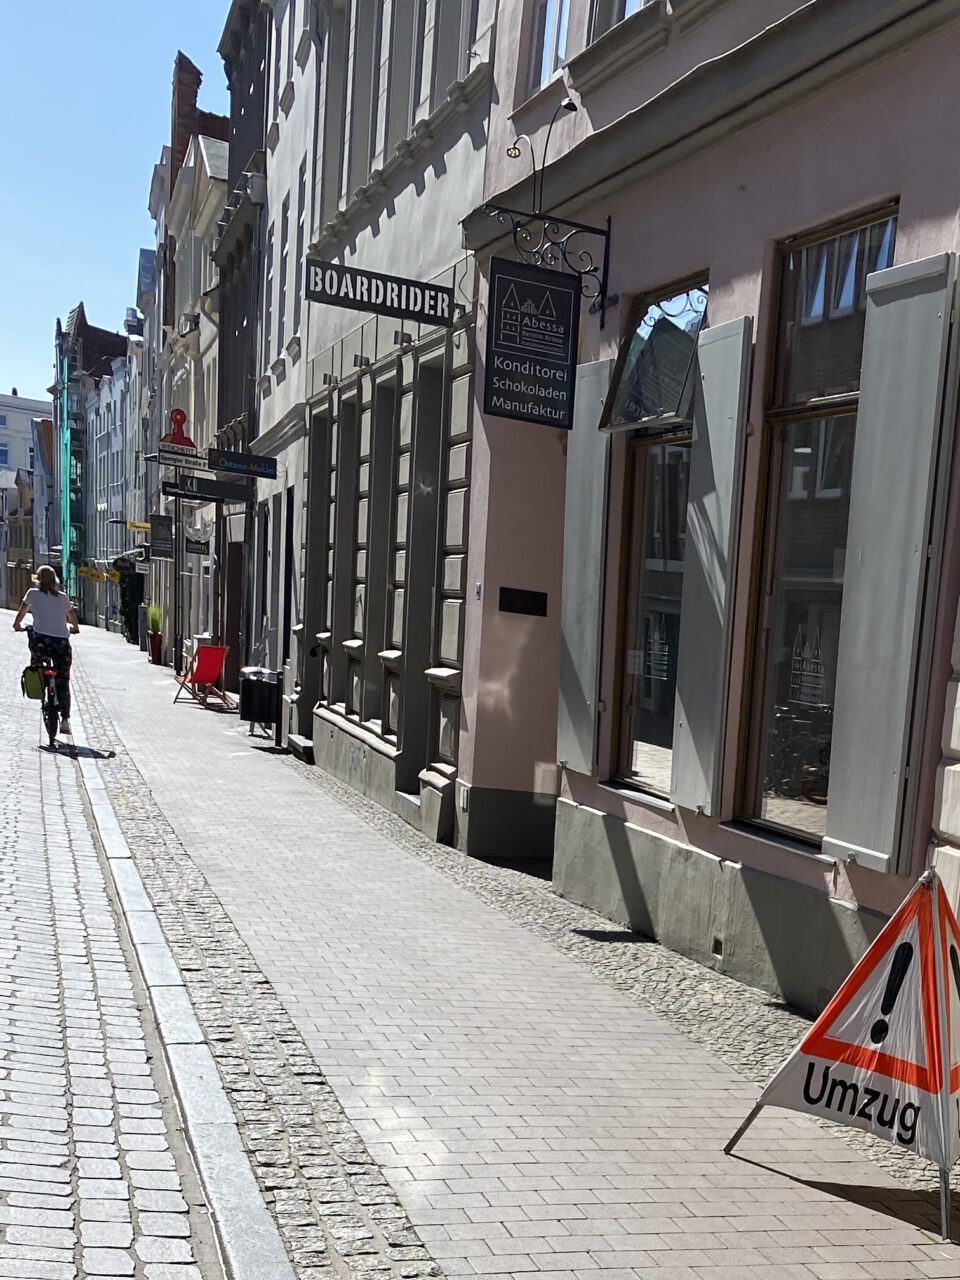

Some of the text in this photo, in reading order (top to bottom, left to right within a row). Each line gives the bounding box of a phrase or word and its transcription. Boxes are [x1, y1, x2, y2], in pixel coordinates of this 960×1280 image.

[309, 265, 450, 318] BOARDRIDER
[522, 316, 564, 334] Abessa
[494, 355, 567, 382] Konditorei
[492, 377, 567, 401] Schokoladen
[491, 396, 566, 419] Manufaktur
[803, 1061, 922, 1146] Umzug
